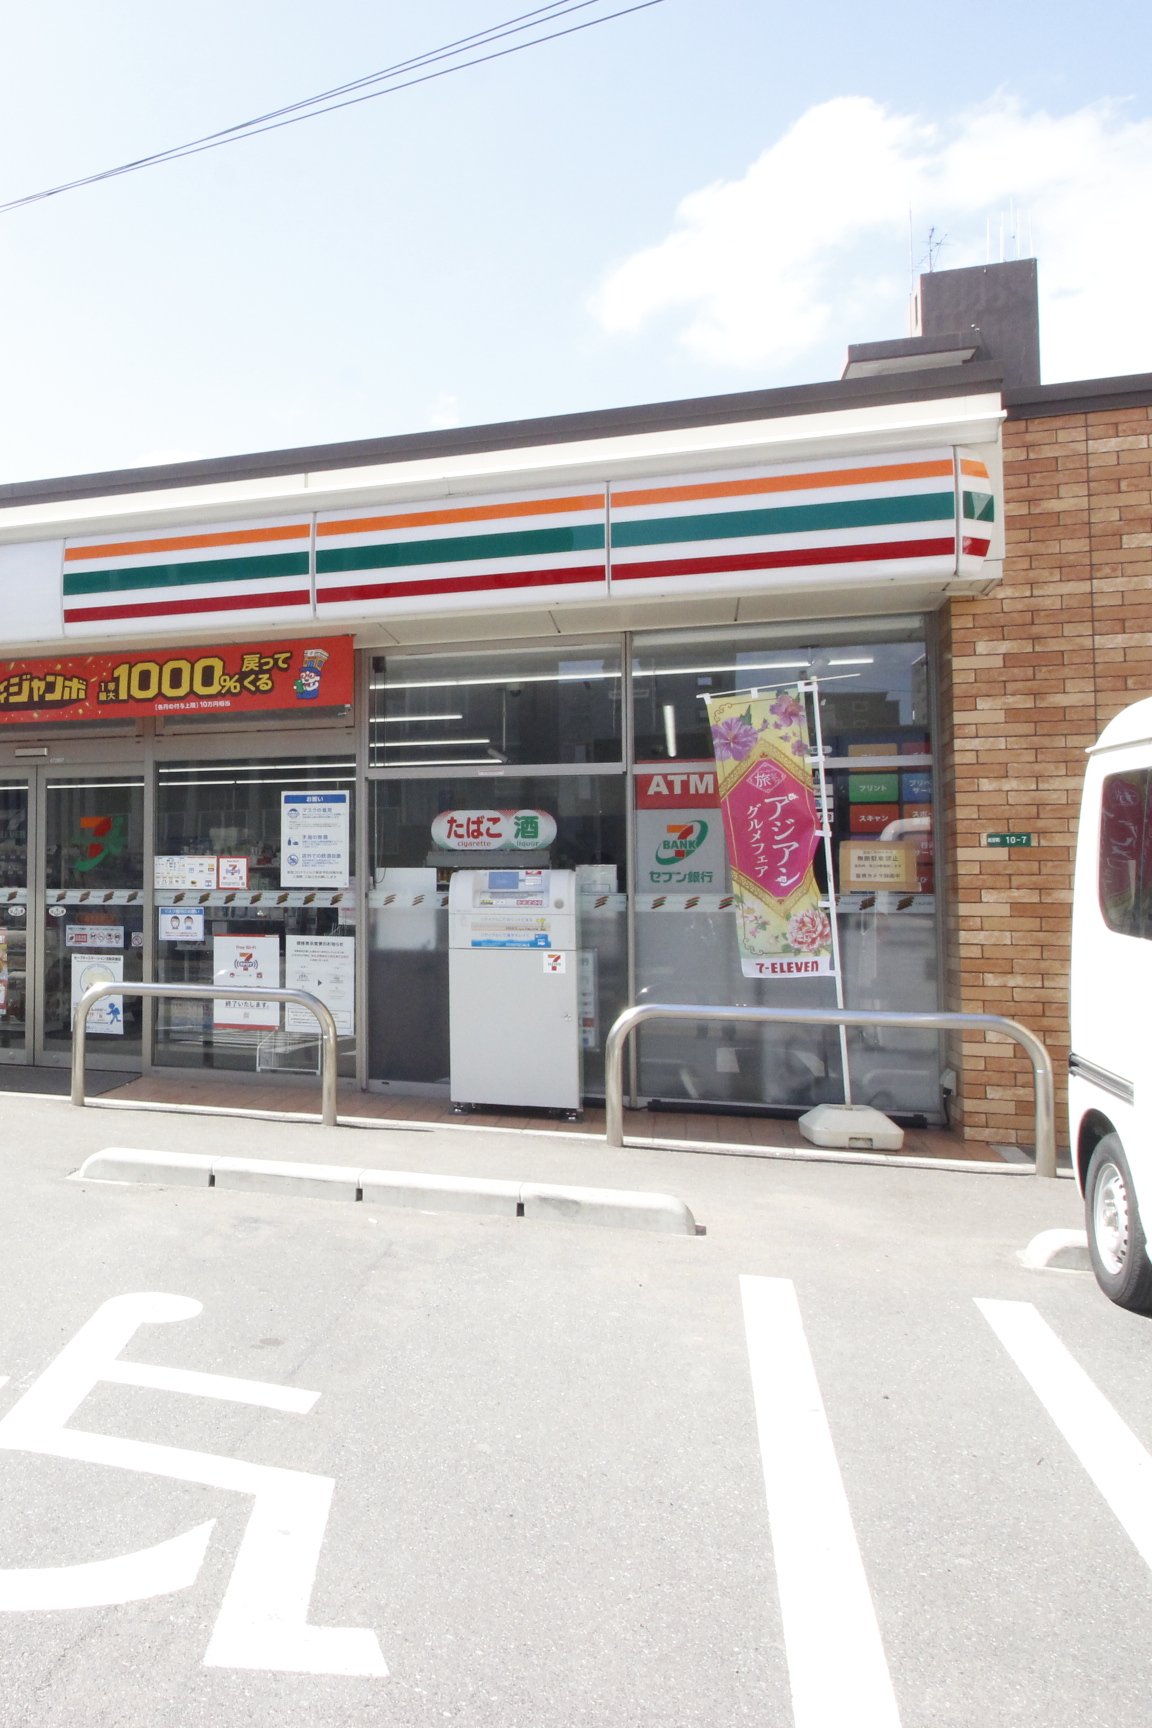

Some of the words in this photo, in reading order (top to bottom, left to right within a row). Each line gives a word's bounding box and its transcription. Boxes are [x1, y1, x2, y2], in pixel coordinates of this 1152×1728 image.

[242, 652, 292, 671] 戻って
[244, 674, 273, 691] くる
[647, 774, 714, 795] ATM
[859, 784, 887, 792] プリント
[447, 815, 503, 839] たばこ
[514, 815, 539, 839] 酒
[663, 840, 697, 850] BANK
[747, 803, 770, 878] グルメフェア
[764, 793, 801, 887] アジアン
[1006, 836, 1027, 844] 10-7
[649, 871, 714, 883] セブン銀行
[755, 960, 819, 974] 7-ELEVEN
